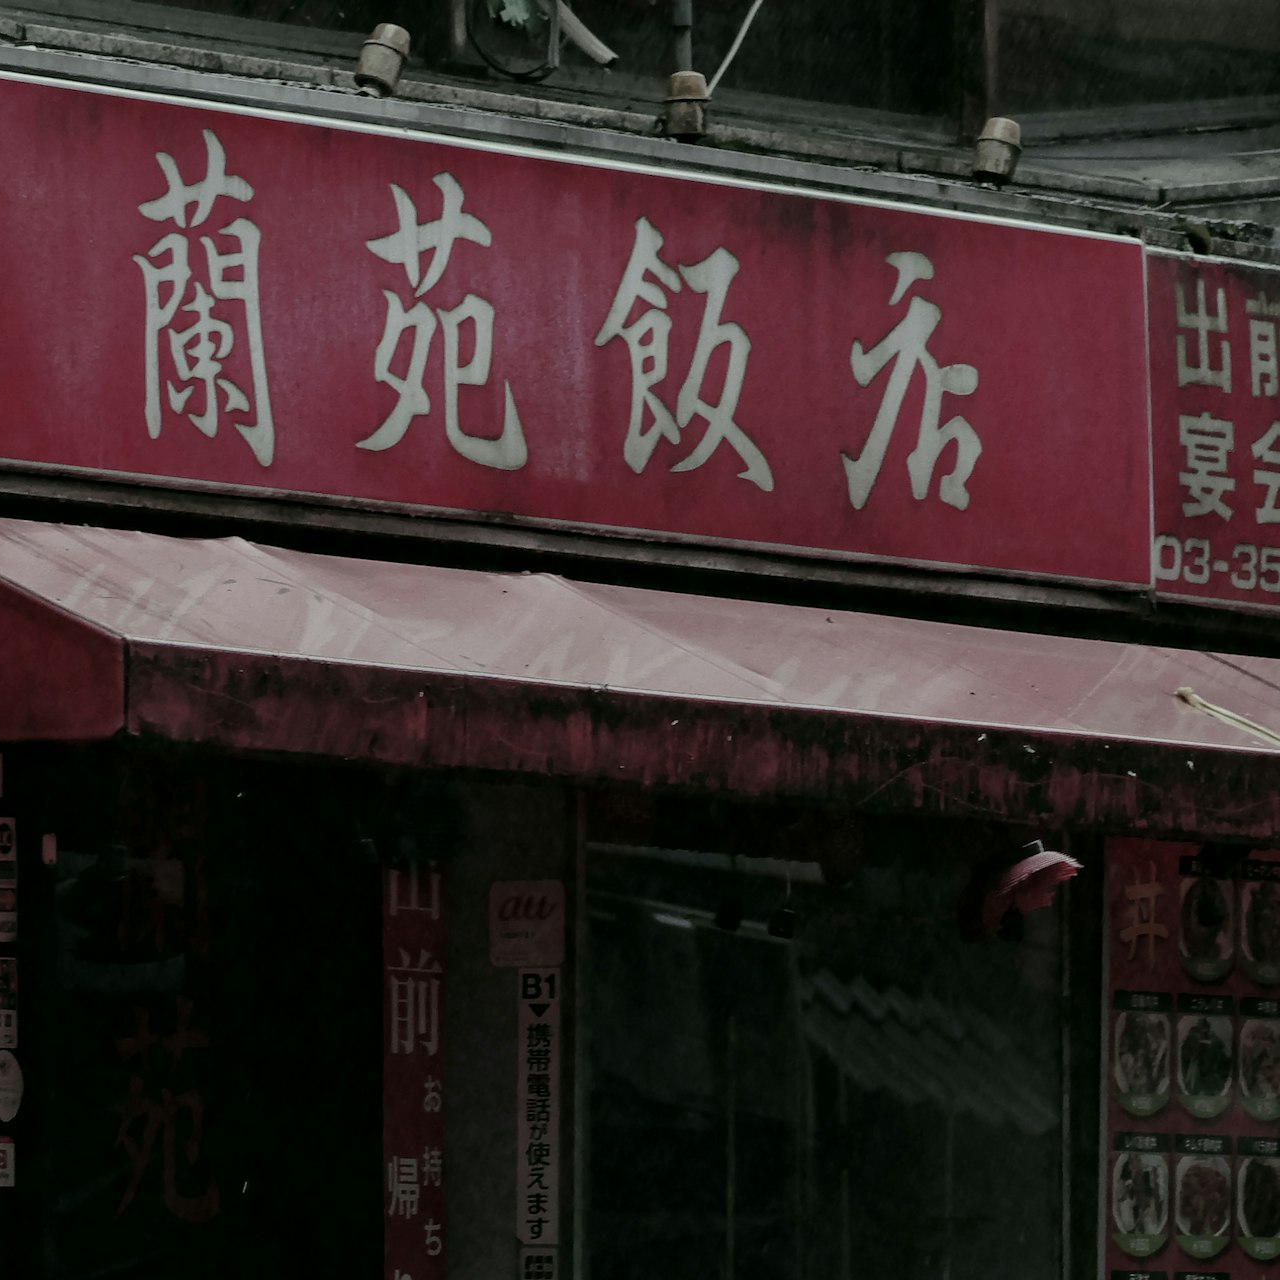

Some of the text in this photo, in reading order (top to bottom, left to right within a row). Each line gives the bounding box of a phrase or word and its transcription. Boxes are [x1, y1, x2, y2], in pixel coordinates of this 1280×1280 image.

[132, 128, 983, 511] 蘭苑飯店
[498, 895, 556, 921] au
[522, 973, 556, 999] B1
[526, 1023, 552, 1240] 携帯電話が使えます
